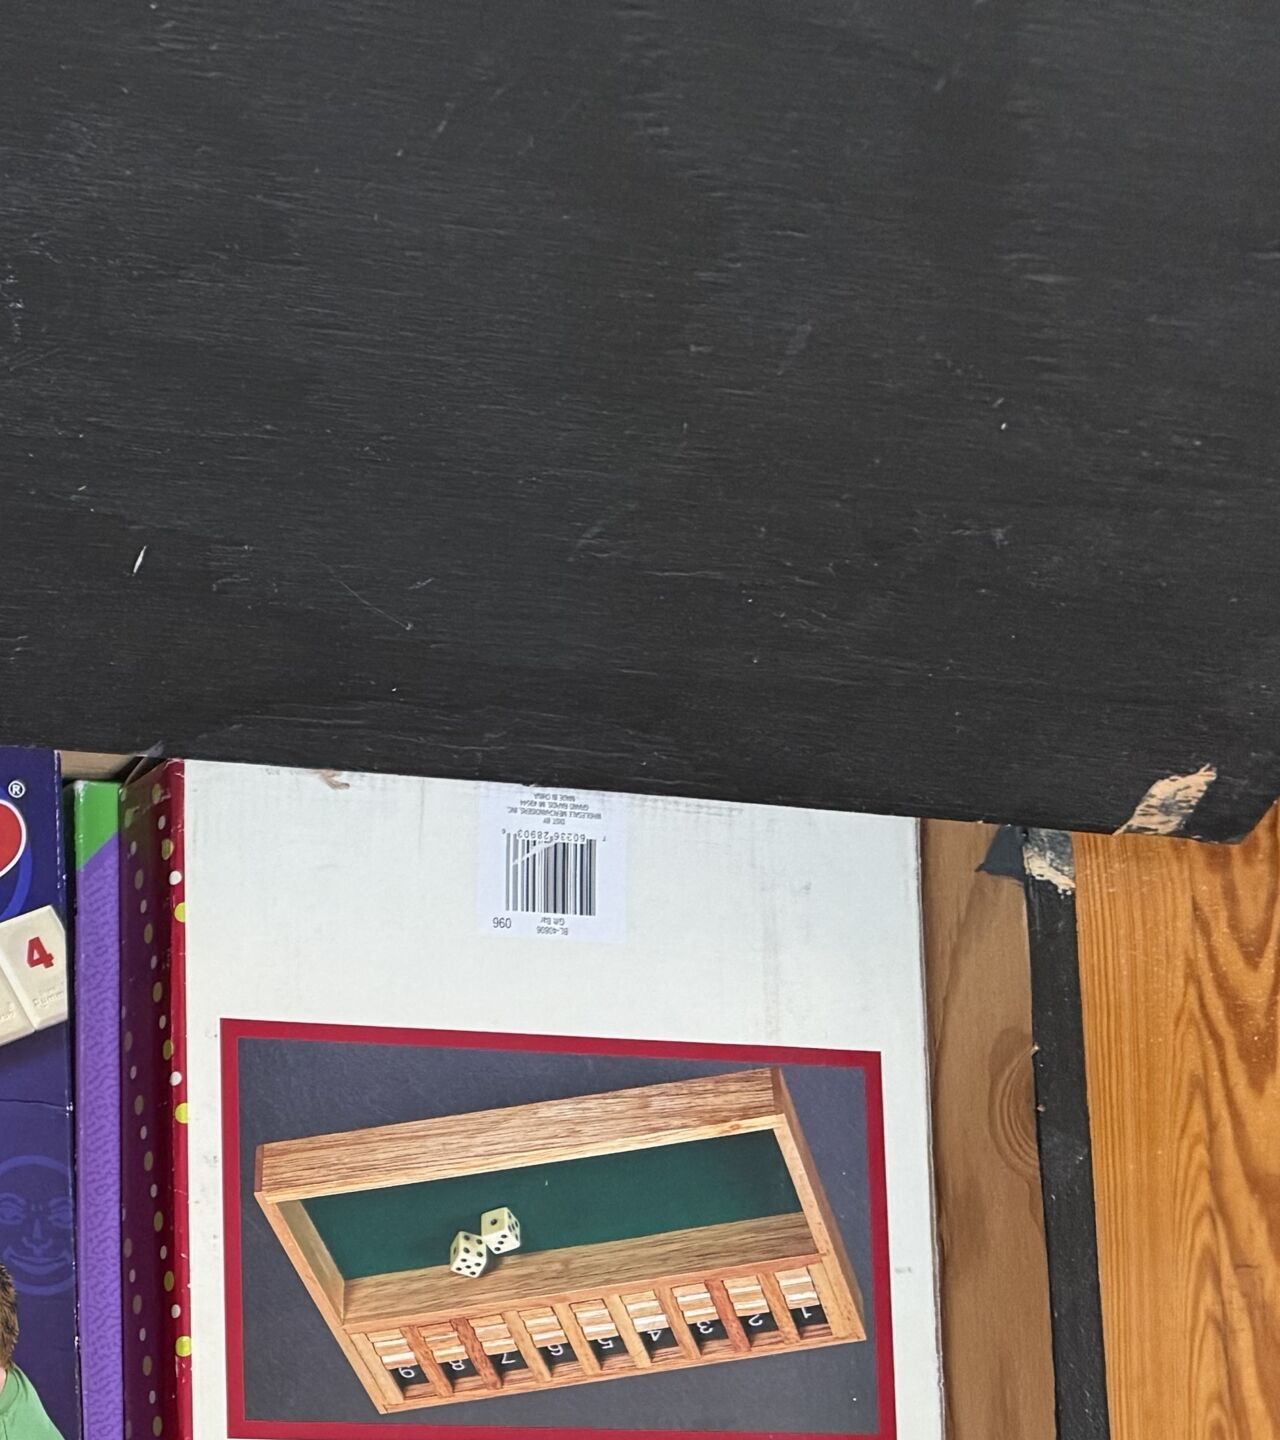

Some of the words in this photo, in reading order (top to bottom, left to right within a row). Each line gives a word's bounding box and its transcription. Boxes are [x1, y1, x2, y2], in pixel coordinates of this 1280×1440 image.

[492, 917, 512, 929] 096
[26, 935, 55, 970] 4
[800, 1306, 814, 1319] 1
